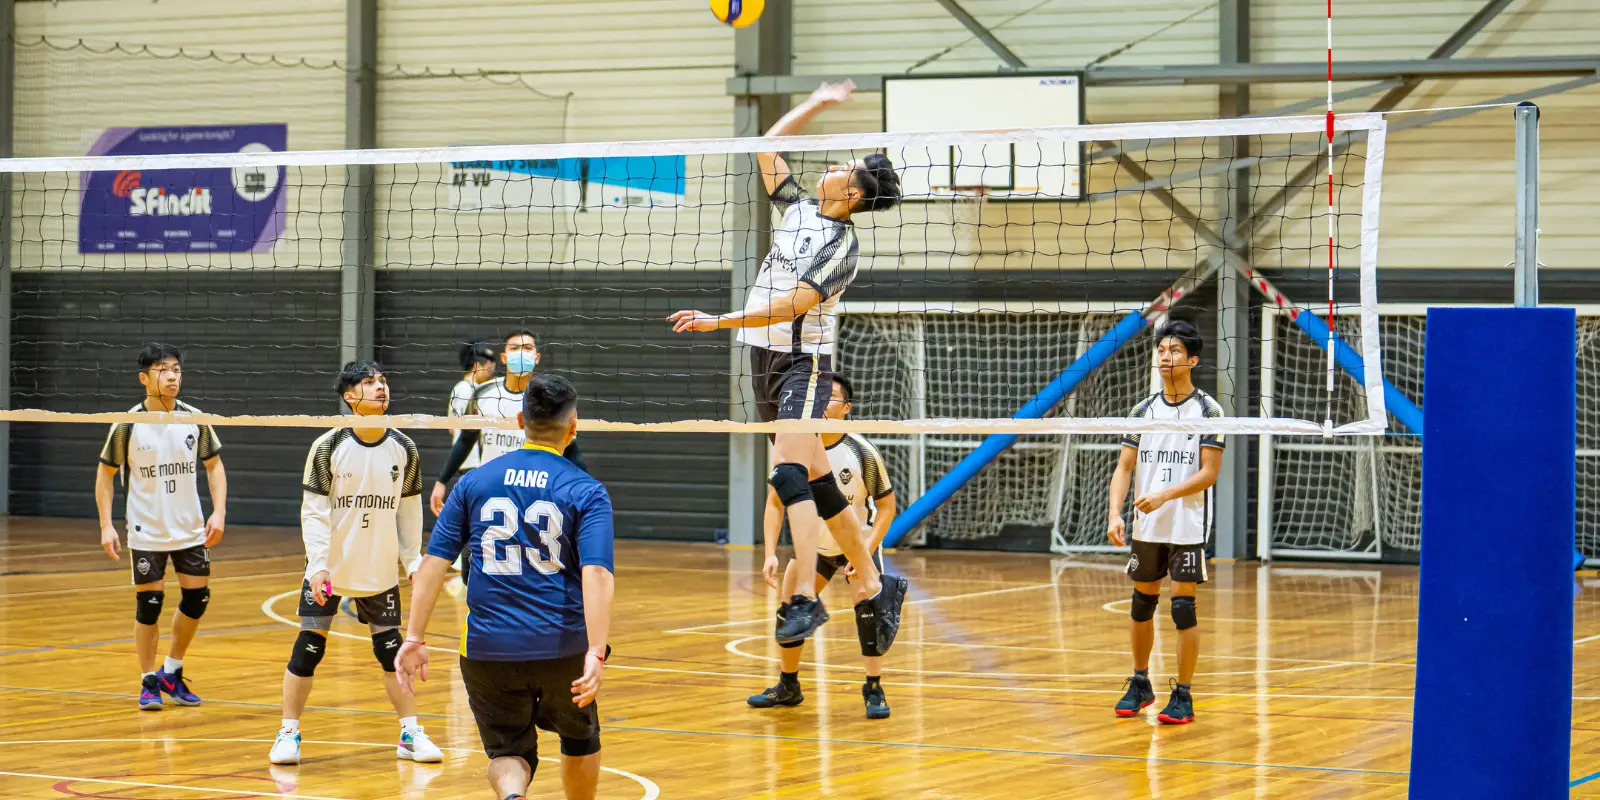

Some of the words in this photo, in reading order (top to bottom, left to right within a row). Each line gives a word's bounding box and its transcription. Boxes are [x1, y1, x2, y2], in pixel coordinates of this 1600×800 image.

[453, 173, 468, 187] AT
[472, 173, 491, 187] VU
[783, 390, 793, 404] 7
[140, 465, 156, 478] ME
[159, 461, 195, 477] MONKE
[1160, 468, 1172, 482] 31
[164, 479, 176, 494] 10
[504, 468, 549, 489] DANG
[334, 495, 354, 509] ME
[355, 494, 396, 509] MONKE
[361, 513, 370, 529] 5
[481, 497, 565, 575] 23
[1182, 551, 1196, 567] 31
[386, 594, 395, 610] 5
